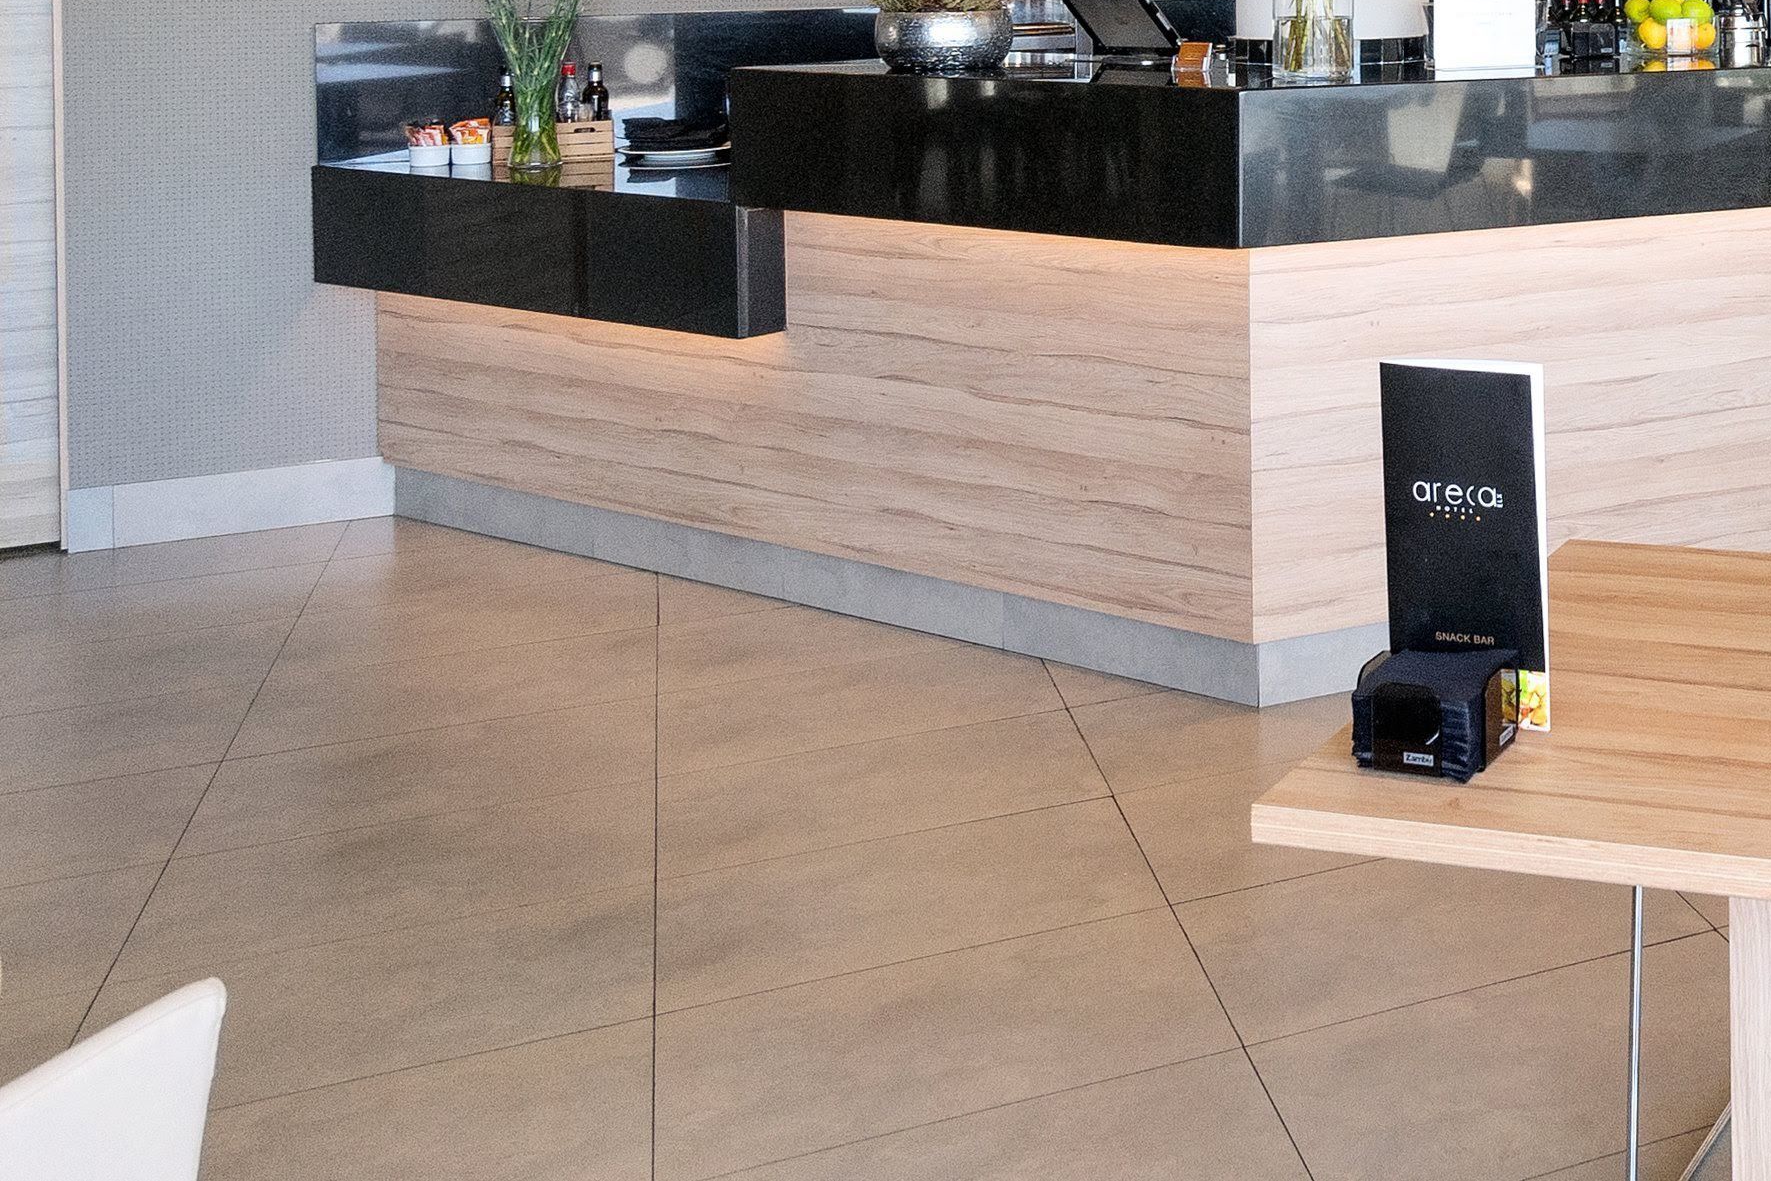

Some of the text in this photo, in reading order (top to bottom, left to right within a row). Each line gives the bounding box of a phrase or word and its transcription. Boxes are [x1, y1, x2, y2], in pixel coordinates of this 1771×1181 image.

[1412, 481, 1497, 508] areca
[1435, 630, 1495, 646] SNACK BAR
